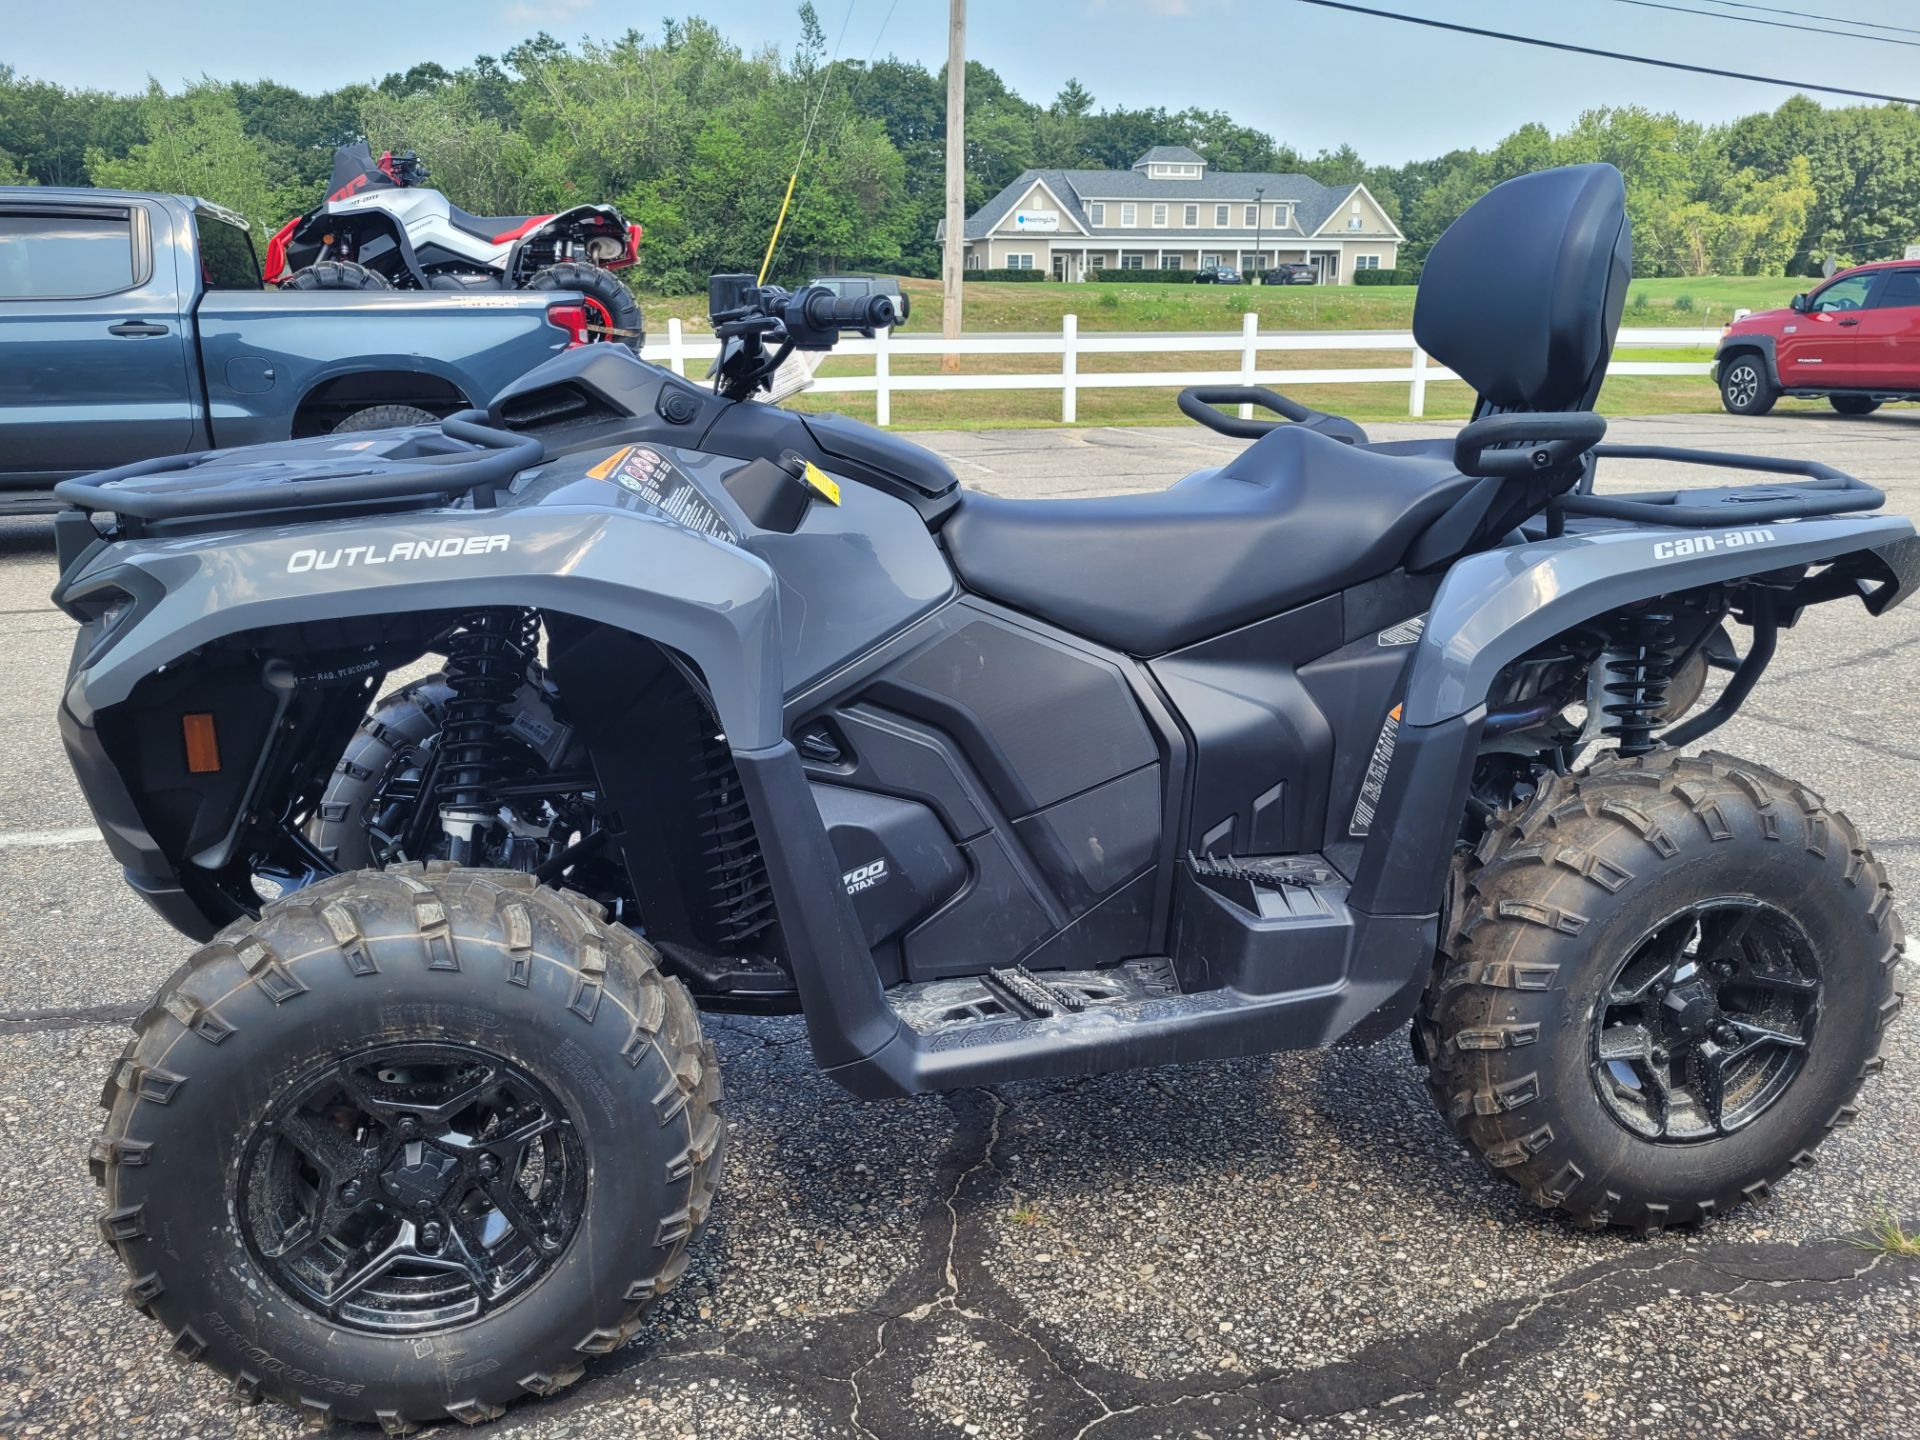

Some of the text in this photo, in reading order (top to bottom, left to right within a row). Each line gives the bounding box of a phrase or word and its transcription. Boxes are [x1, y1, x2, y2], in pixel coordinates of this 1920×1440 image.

[287, 534, 511, 574] OUTLANDER
[1653, 529, 1776, 560] can-am
[846, 877, 875, 895] OTAX
